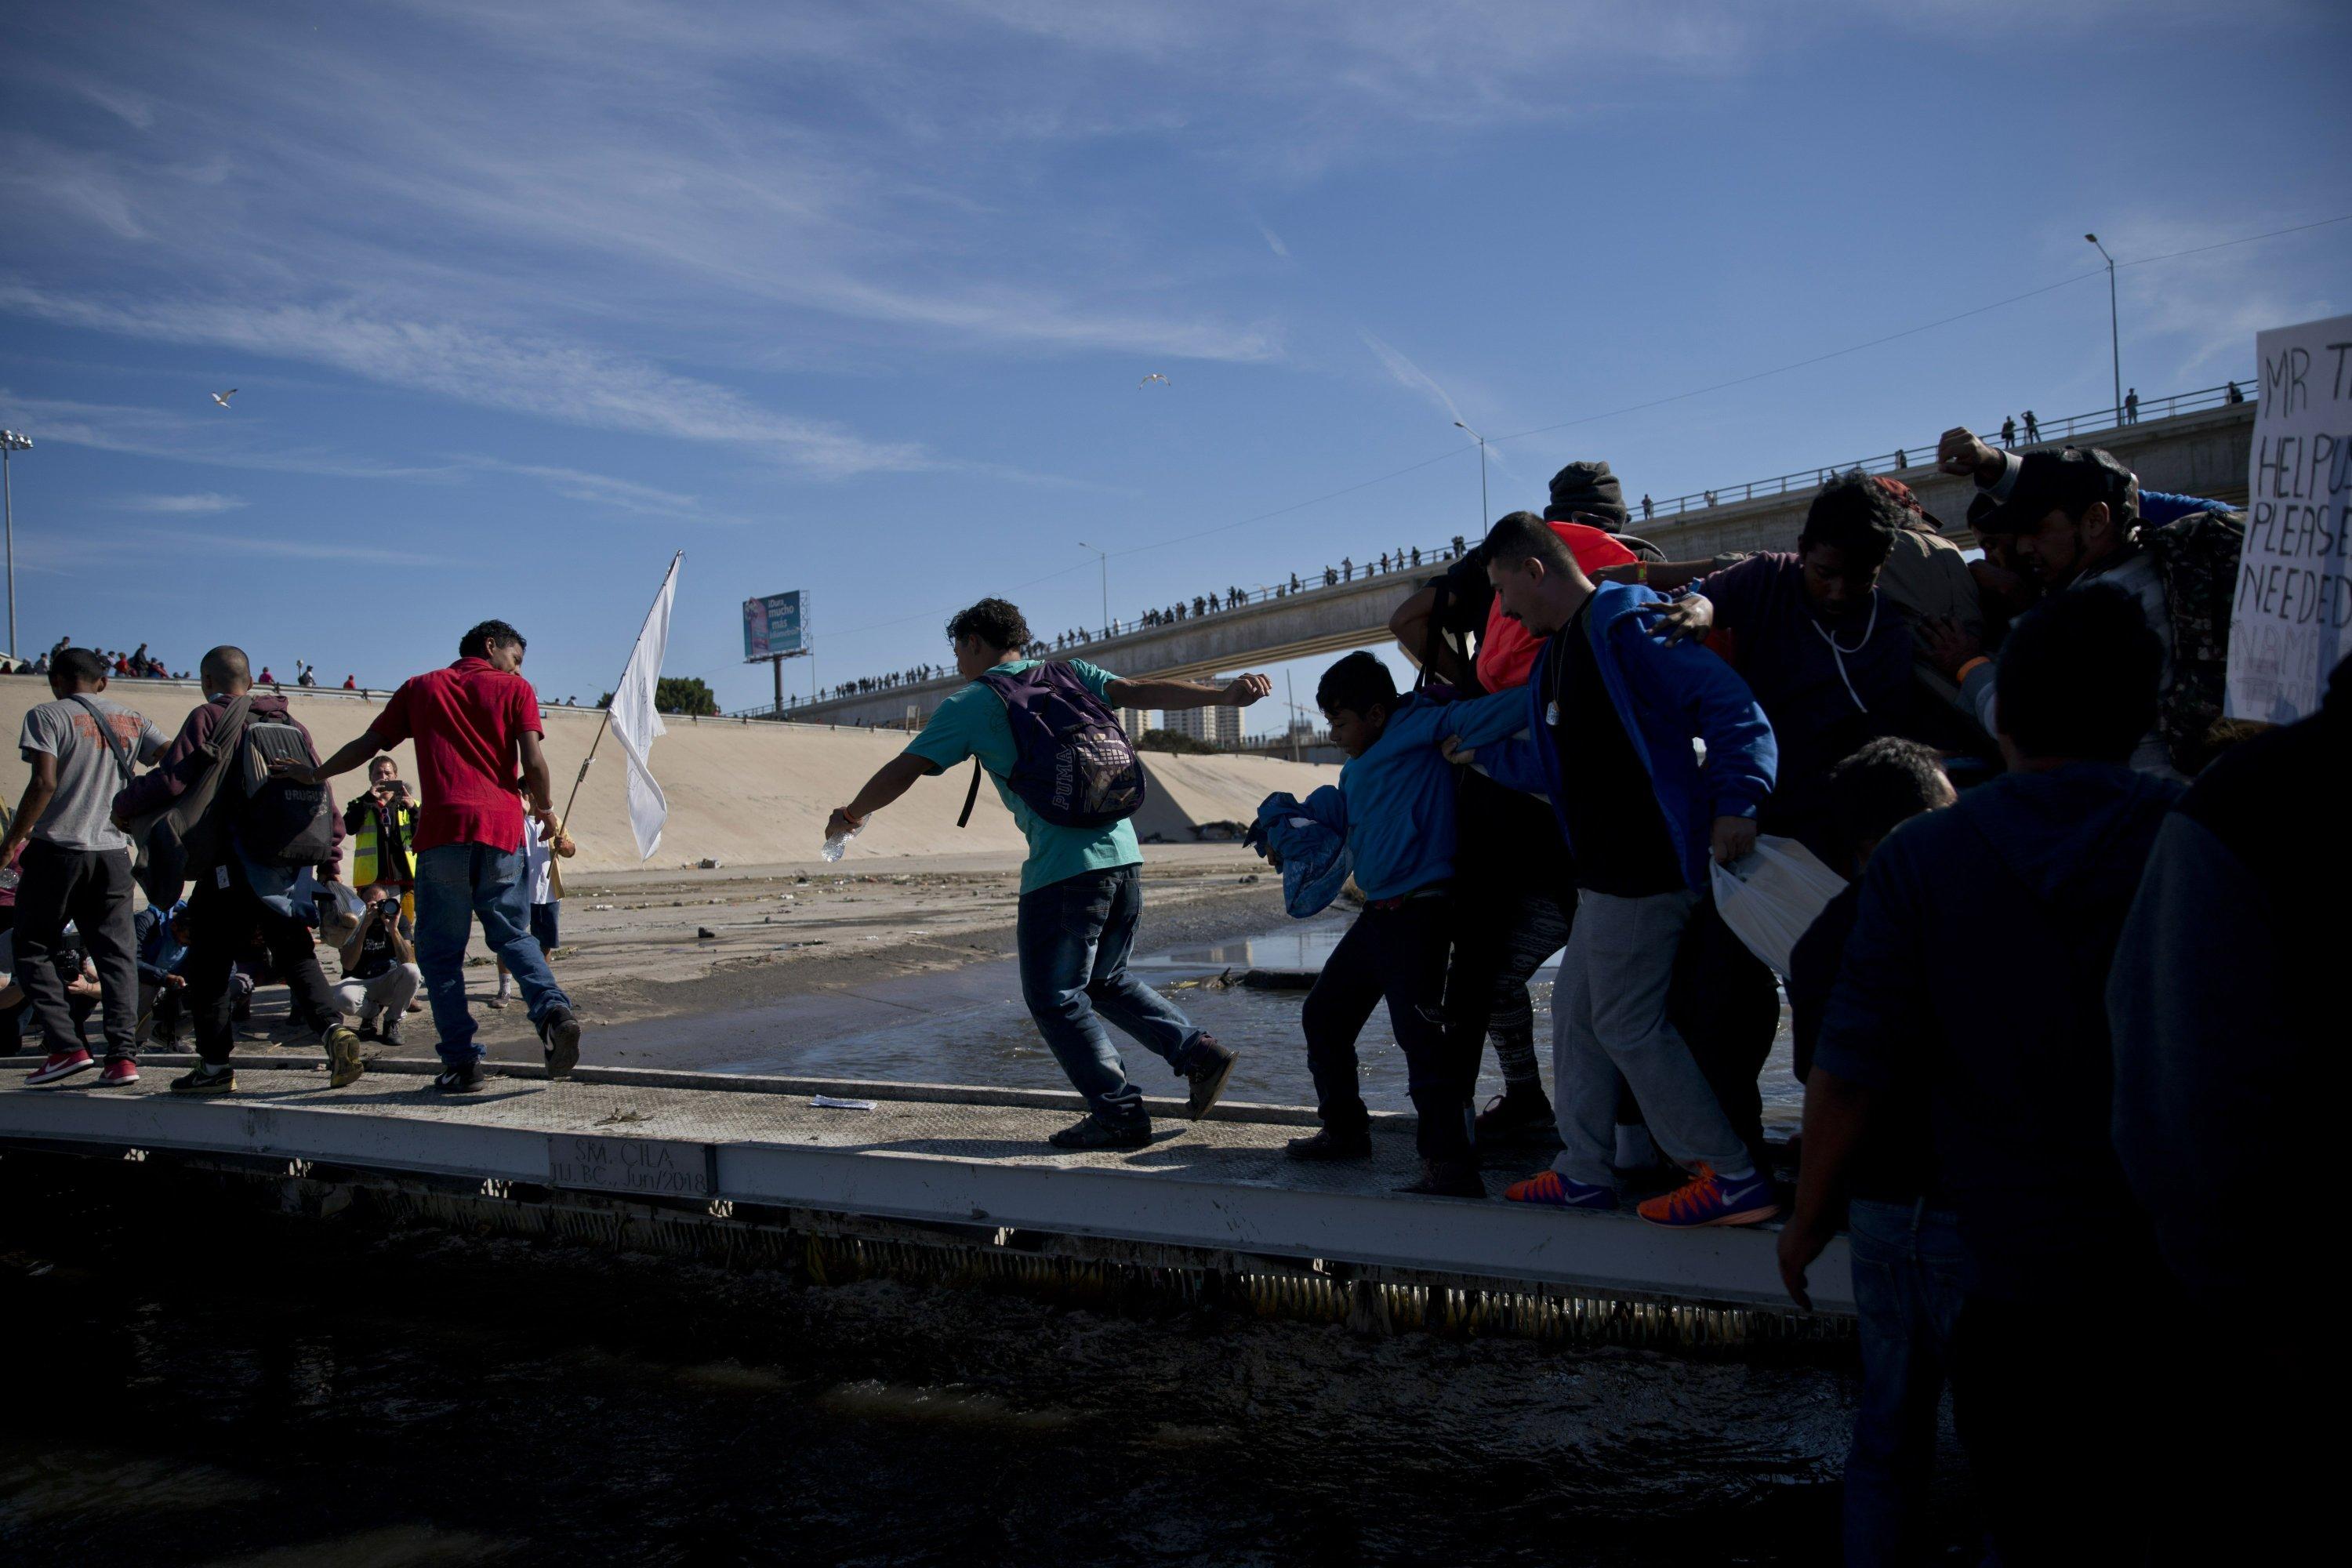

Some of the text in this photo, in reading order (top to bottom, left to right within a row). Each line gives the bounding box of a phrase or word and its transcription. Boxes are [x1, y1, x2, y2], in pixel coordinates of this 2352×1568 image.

[2265, 343, 2352, 419] MR T
[768, 604, 794, 618] mucho
[2238, 563, 2352, 630] NEEDED
[1052, 743, 1073, 811] PUMA
[621, 1142, 675, 1170] CILA
